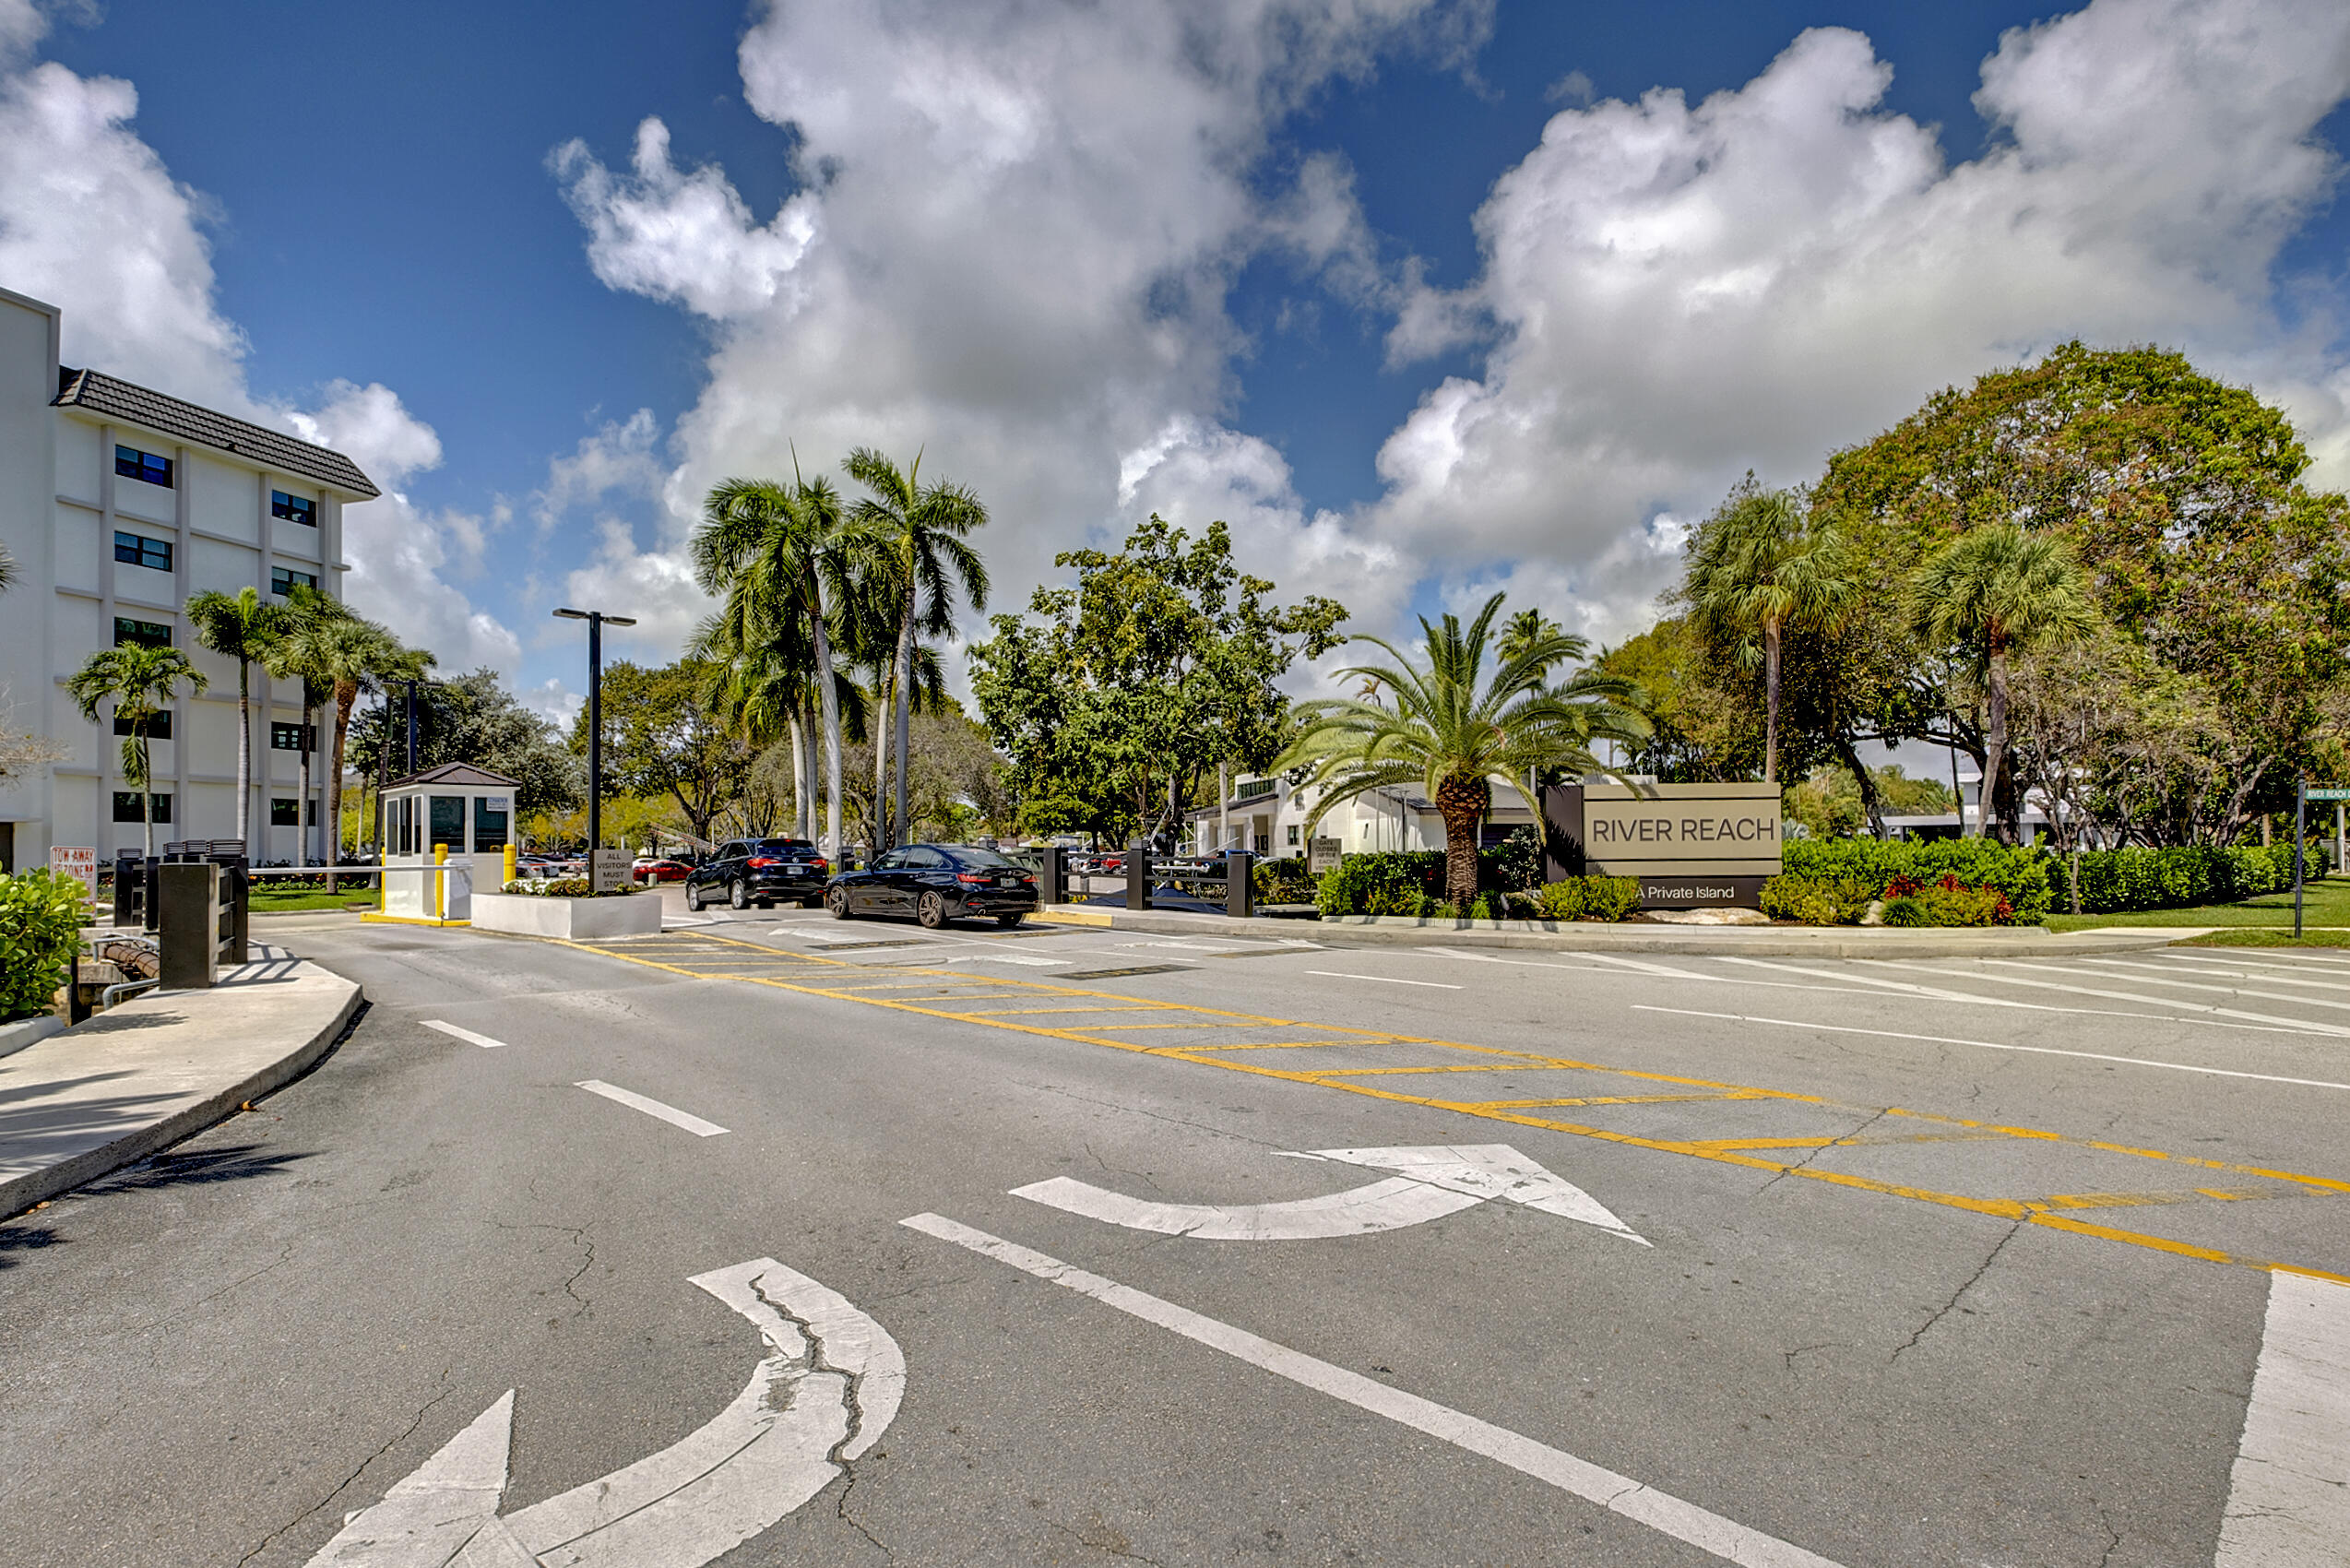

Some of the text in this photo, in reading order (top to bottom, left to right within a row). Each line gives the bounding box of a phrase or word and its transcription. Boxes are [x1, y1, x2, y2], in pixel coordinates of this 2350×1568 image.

[2308, 790, 2324, 798] RIVER
[2326, 790, 2346, 798] REACH
[1593, 817, 1774, 842] RIVER REACH
[53, 849, 69, 862] TOW
[64, 864, 85, 878] ZONE
[1635, 886, 1735, 899] A Private Island
